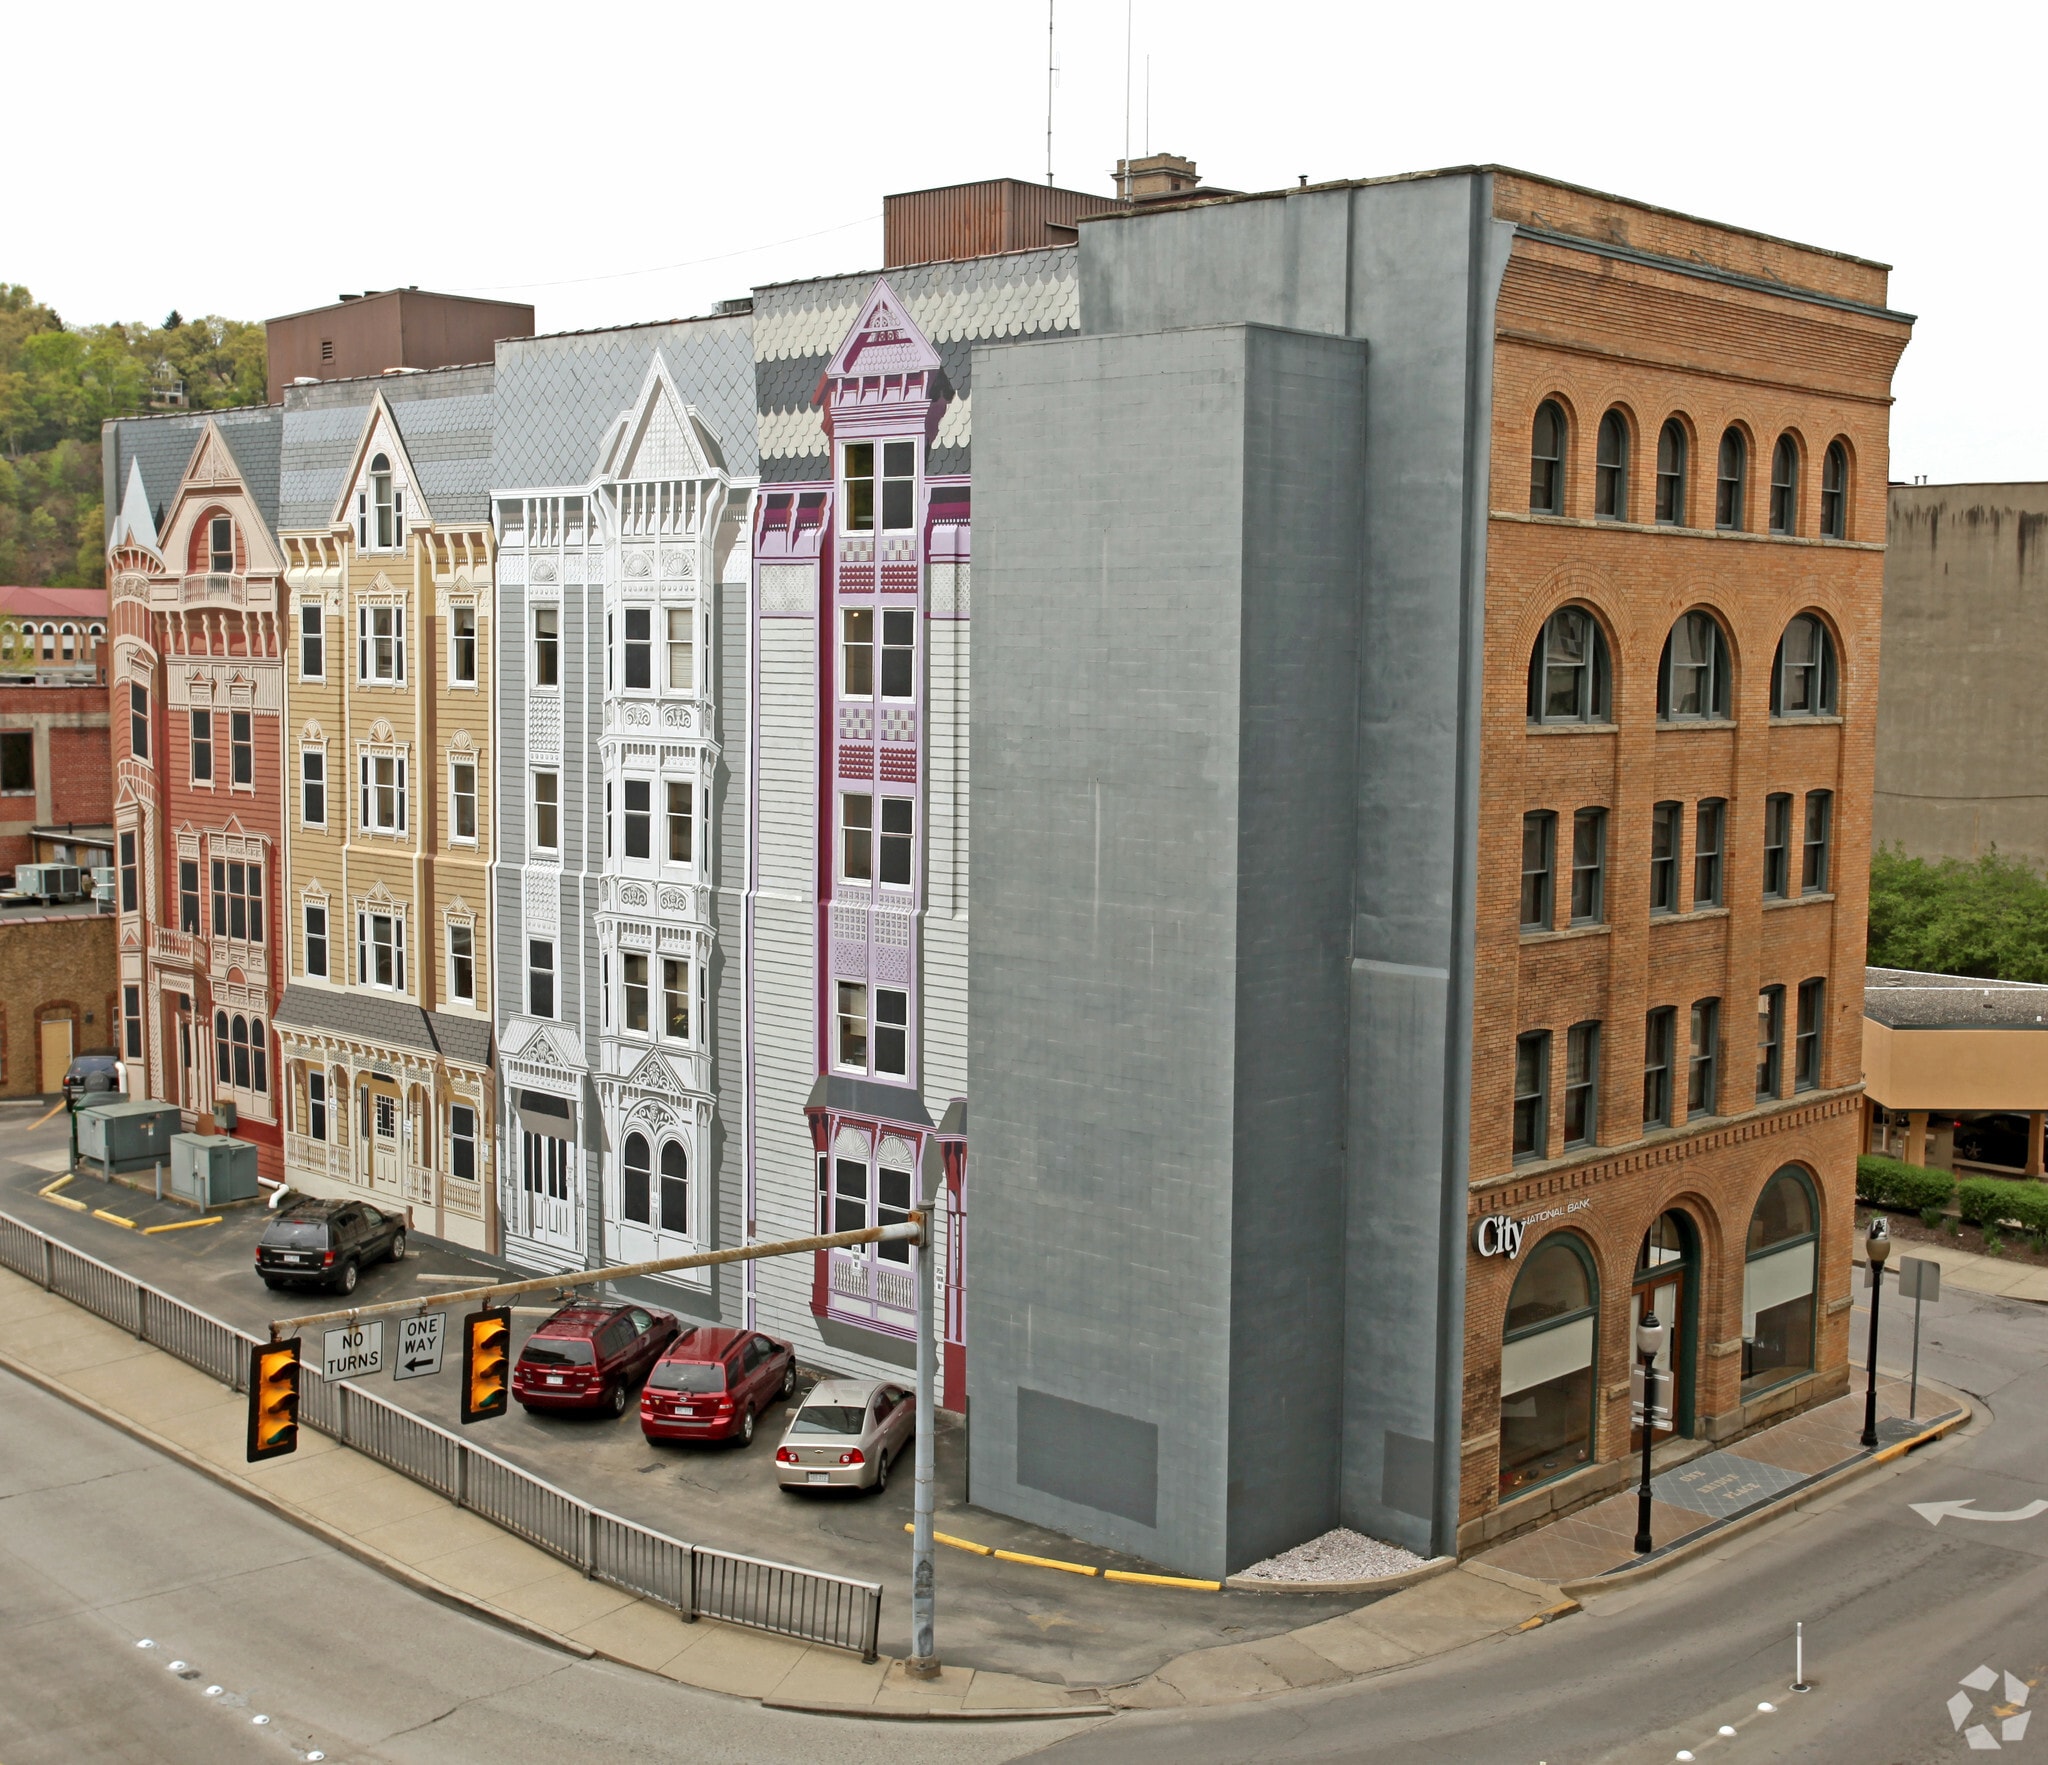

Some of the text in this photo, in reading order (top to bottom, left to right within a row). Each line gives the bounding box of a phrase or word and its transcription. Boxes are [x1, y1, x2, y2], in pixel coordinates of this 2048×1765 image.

[1478, 1215, 1527, 1260] City
[1567, 1198, 1590, 1213] BANK
[407, 1318, 438, 1336] ONE
[342, 1332, 364, 1349] NO
[405, 1336, 437, 1354] WAY
[328, 1351, 378, 1374] TURNS
[1680, 1470, 1706, 1482] ONE
[1696, 1474, 1739, 1493] BRIDGE
[1722, 1483, 1760, 1499] PLACE
